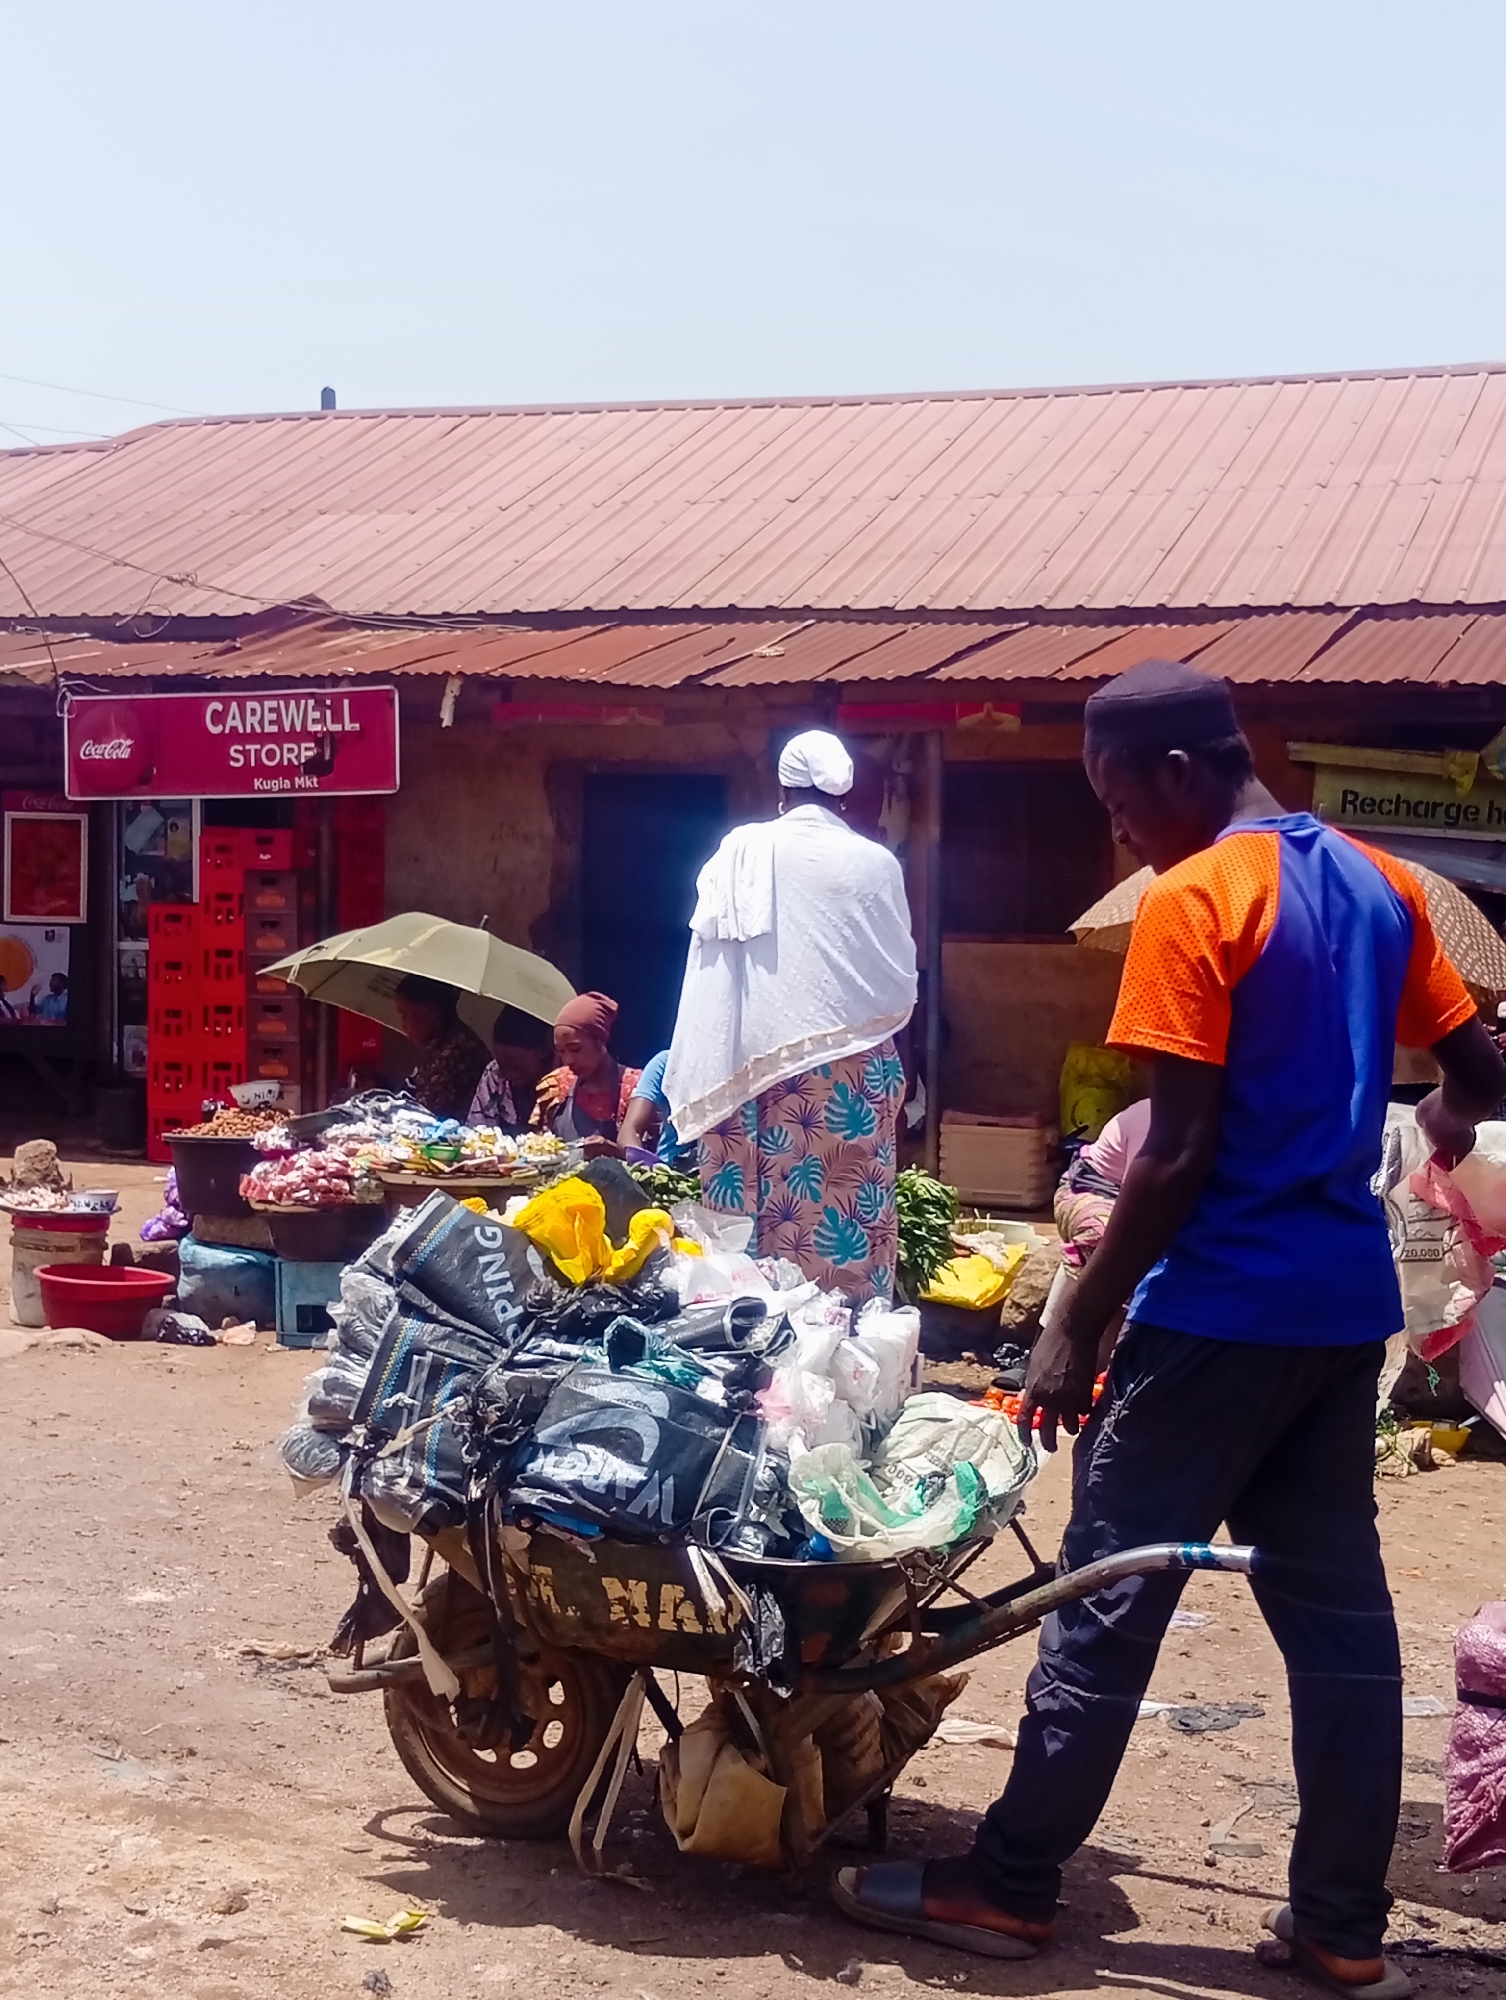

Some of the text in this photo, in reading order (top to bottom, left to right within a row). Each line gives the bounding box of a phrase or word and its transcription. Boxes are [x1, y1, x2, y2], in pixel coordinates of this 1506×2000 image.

[205, 699, 361, 735] CAREWELL
[294, 776, 319, 788] Mkt
[1340, 789, 1480, 826] Recharge
